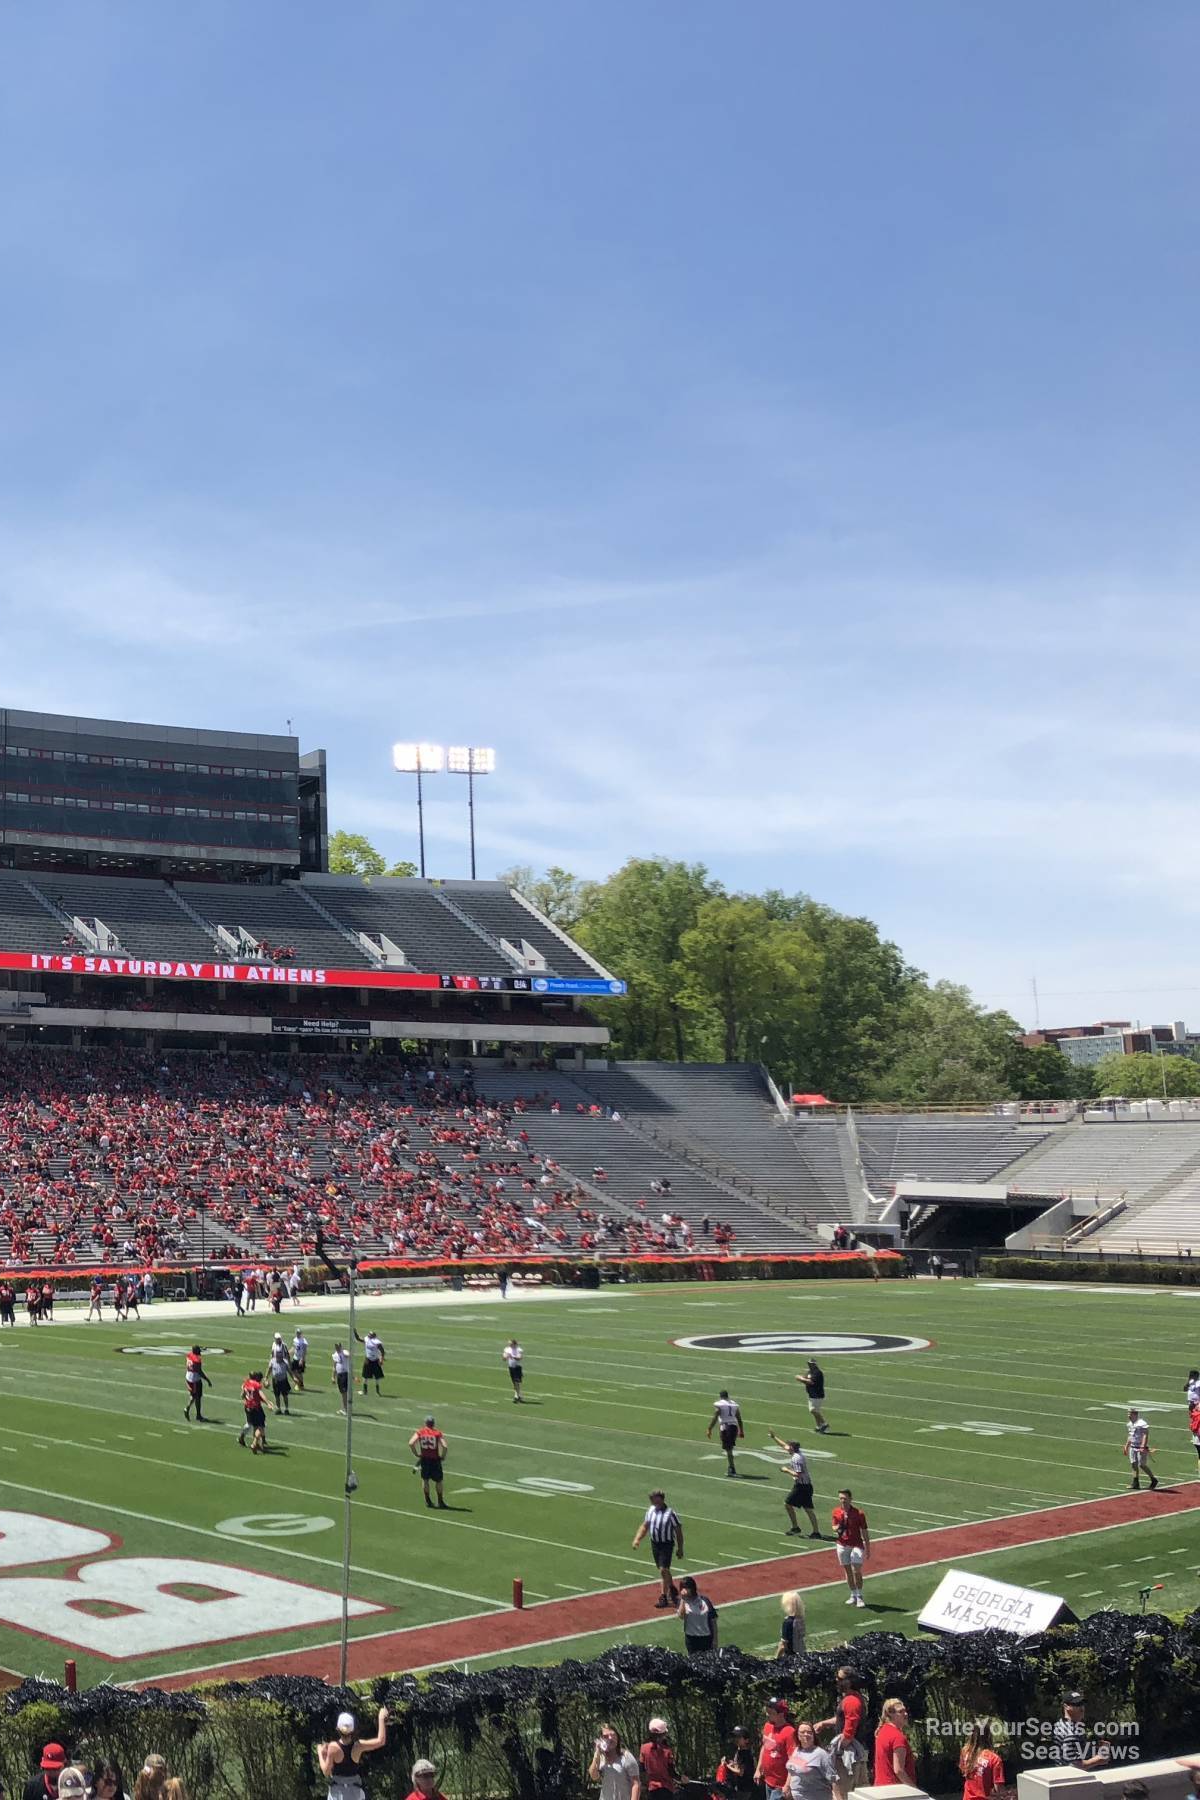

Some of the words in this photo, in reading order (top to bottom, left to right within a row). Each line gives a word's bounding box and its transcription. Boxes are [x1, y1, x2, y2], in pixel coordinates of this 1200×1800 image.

[31, 955, 73, 970] IT'S
[85, 958, 202, 977] SATURDAY
[214, 965, 234, 979] IN
[247, 966, 326, 983] ATHENS
[727, 1405, 732, 1417] 1
[420, 1436, 437, 1449] 29
[952, 1584, 1035, 1619] GEORGIA
[941, 1602, 1026, 1631] MASCOT
